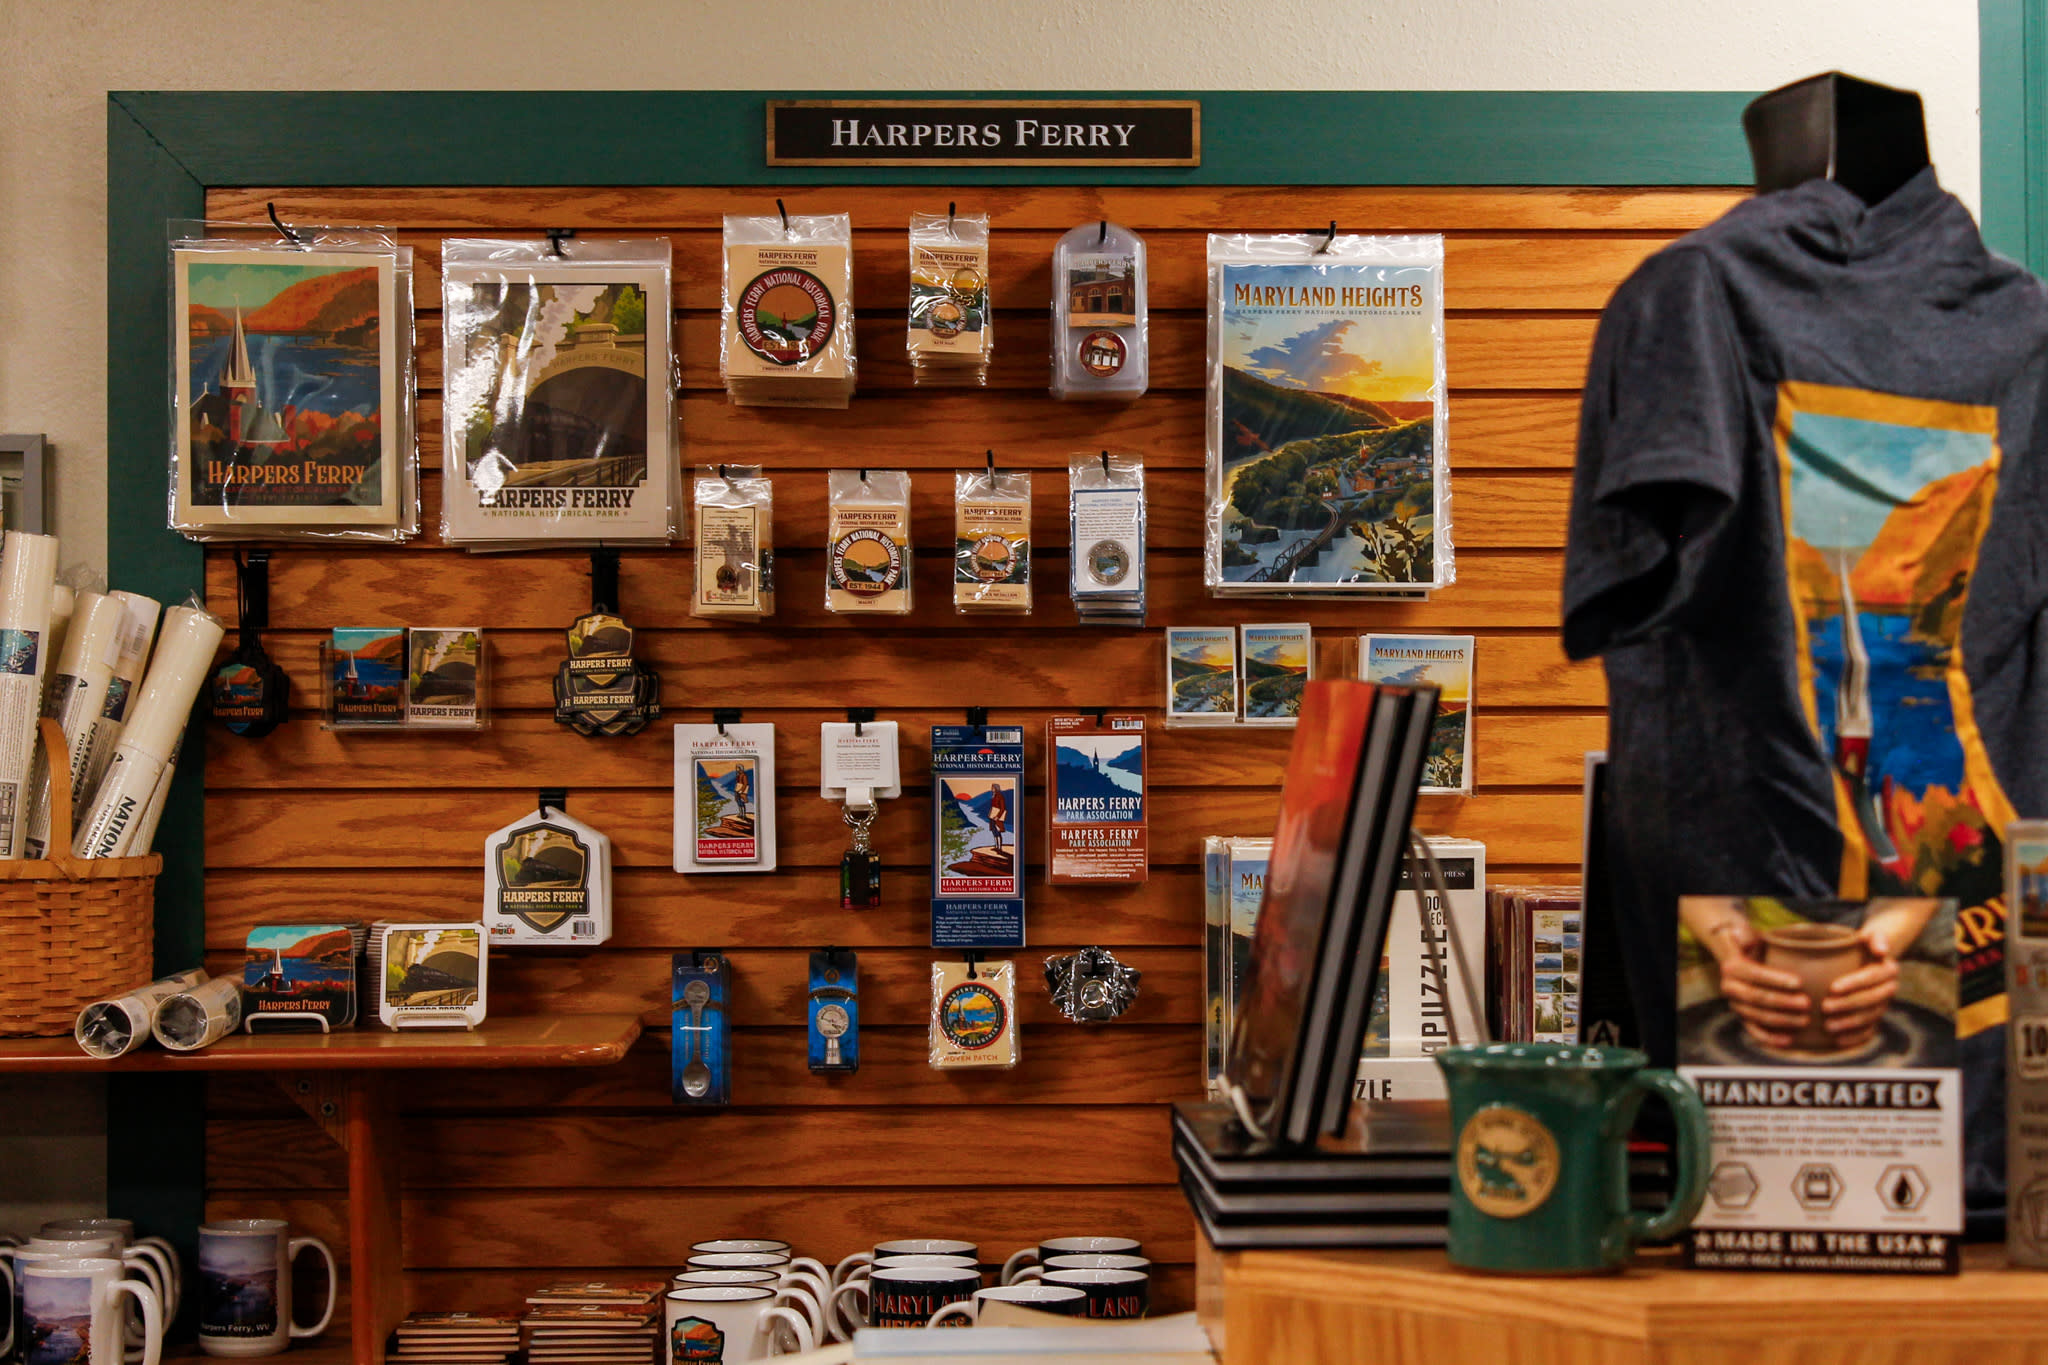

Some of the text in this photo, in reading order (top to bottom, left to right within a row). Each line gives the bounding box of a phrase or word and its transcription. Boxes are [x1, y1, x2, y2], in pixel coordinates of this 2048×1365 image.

[831, 118, 1136, 147] HARPERS FERRY
[794, 252, 817, 260] FERRY
[955, 254, 979, 262] FERRY
[1234, 283, 1423, 308] MARYLAND HEIGHTS
[743, 273, 830, 343] HARPERS FERRY NATIONAL HISTORICAL PARK
[207, 460, 365, 484] HARPERS FERRY
[571, 489, 635, 508] FERRY
[999, 508, 1023, 516] FERRY
[836, 536, 852, 556] FERRY
[849, 529, 880, 541] NATIONAL
[884, 568, 899, 585] PARK
[1375, 647, 1464, 660] MARYLAND HEIGHTS
[570, 659, 632, 669] HARPERS FERRY
[573, 696, 608, 704] HARPERS
[609, 695, 635, 704] FERRY
[338, 703, 397, 713] HARPERS FERRY
[410, 707, 475, 717] HARPERS FERRY
[71, 732, 86, 771] POSTER
[933, 753, 1022, 762] HARPERS FERRY
[1058, 797, 1142, 810] HARPERS FERRY
[1066, 811, 1133, 820] PARK ASSOCIATION
[93, 796, 137, 860] NATION
[1061, 829, 1139, 840] HARPERS FERRY
[942, 879, 1013, 887] HARPERS FERRY
[503, 891, 585, 902] HARPERS FERRY
[945, 985, 996, 1006] HARPERS FERRY
[258, 999, 331, 1011] HARPERS FERRY
[967, 1027, 1000, 1045] VIRGINIA
[943, 1054, 998, 1063] WOVEN PATCH
[1355, 1079, 1392, 1101] ZLE
[1703, 1080, 1932, 1106] HANDCRAFTED
[1714, 1232, 1925, 1252] MADE IN THE USA
[1090, 1295, 1140, 1317] LAND
